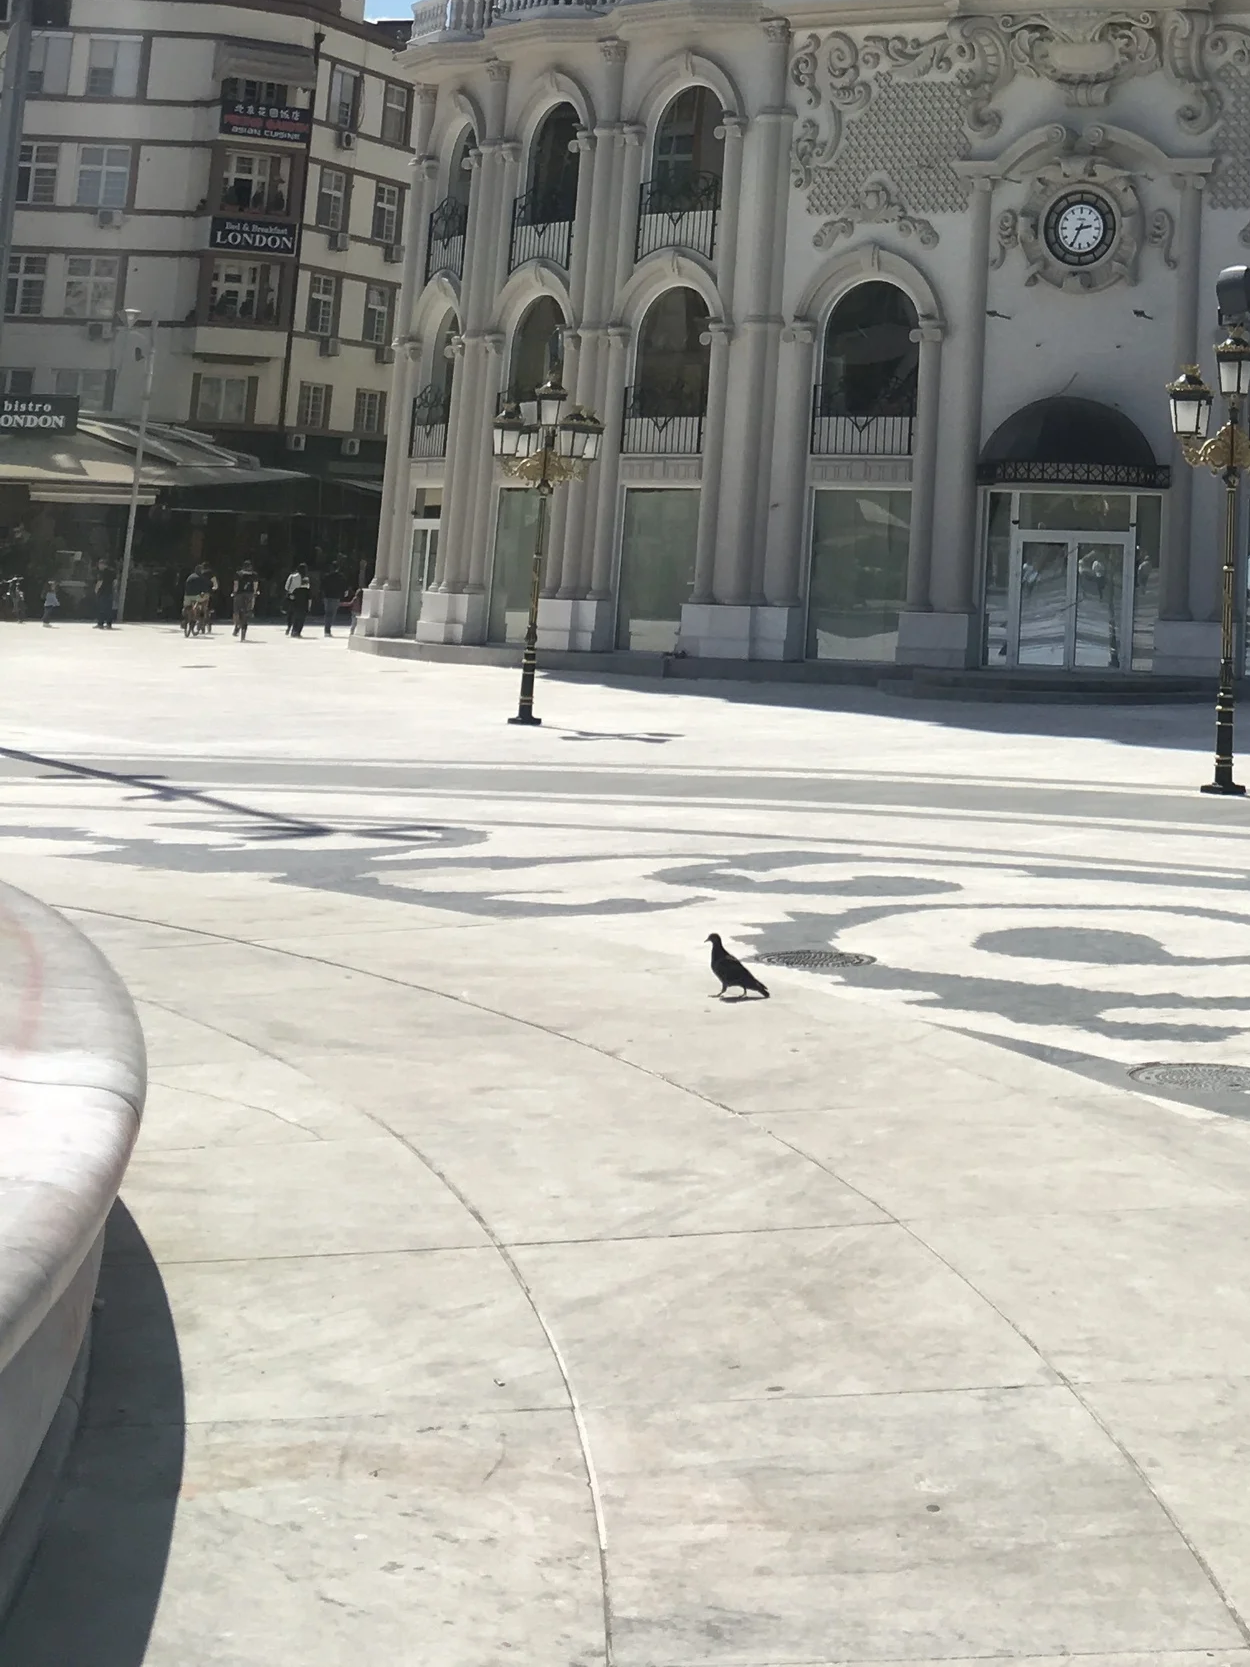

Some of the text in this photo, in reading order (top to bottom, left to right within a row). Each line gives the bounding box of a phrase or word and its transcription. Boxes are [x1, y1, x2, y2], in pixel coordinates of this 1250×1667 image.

[225, 221, 288, 235] Bed & Breakfast
[215, 230, 294, 250] LONDON
[3, 400, 52, 412] bistro
